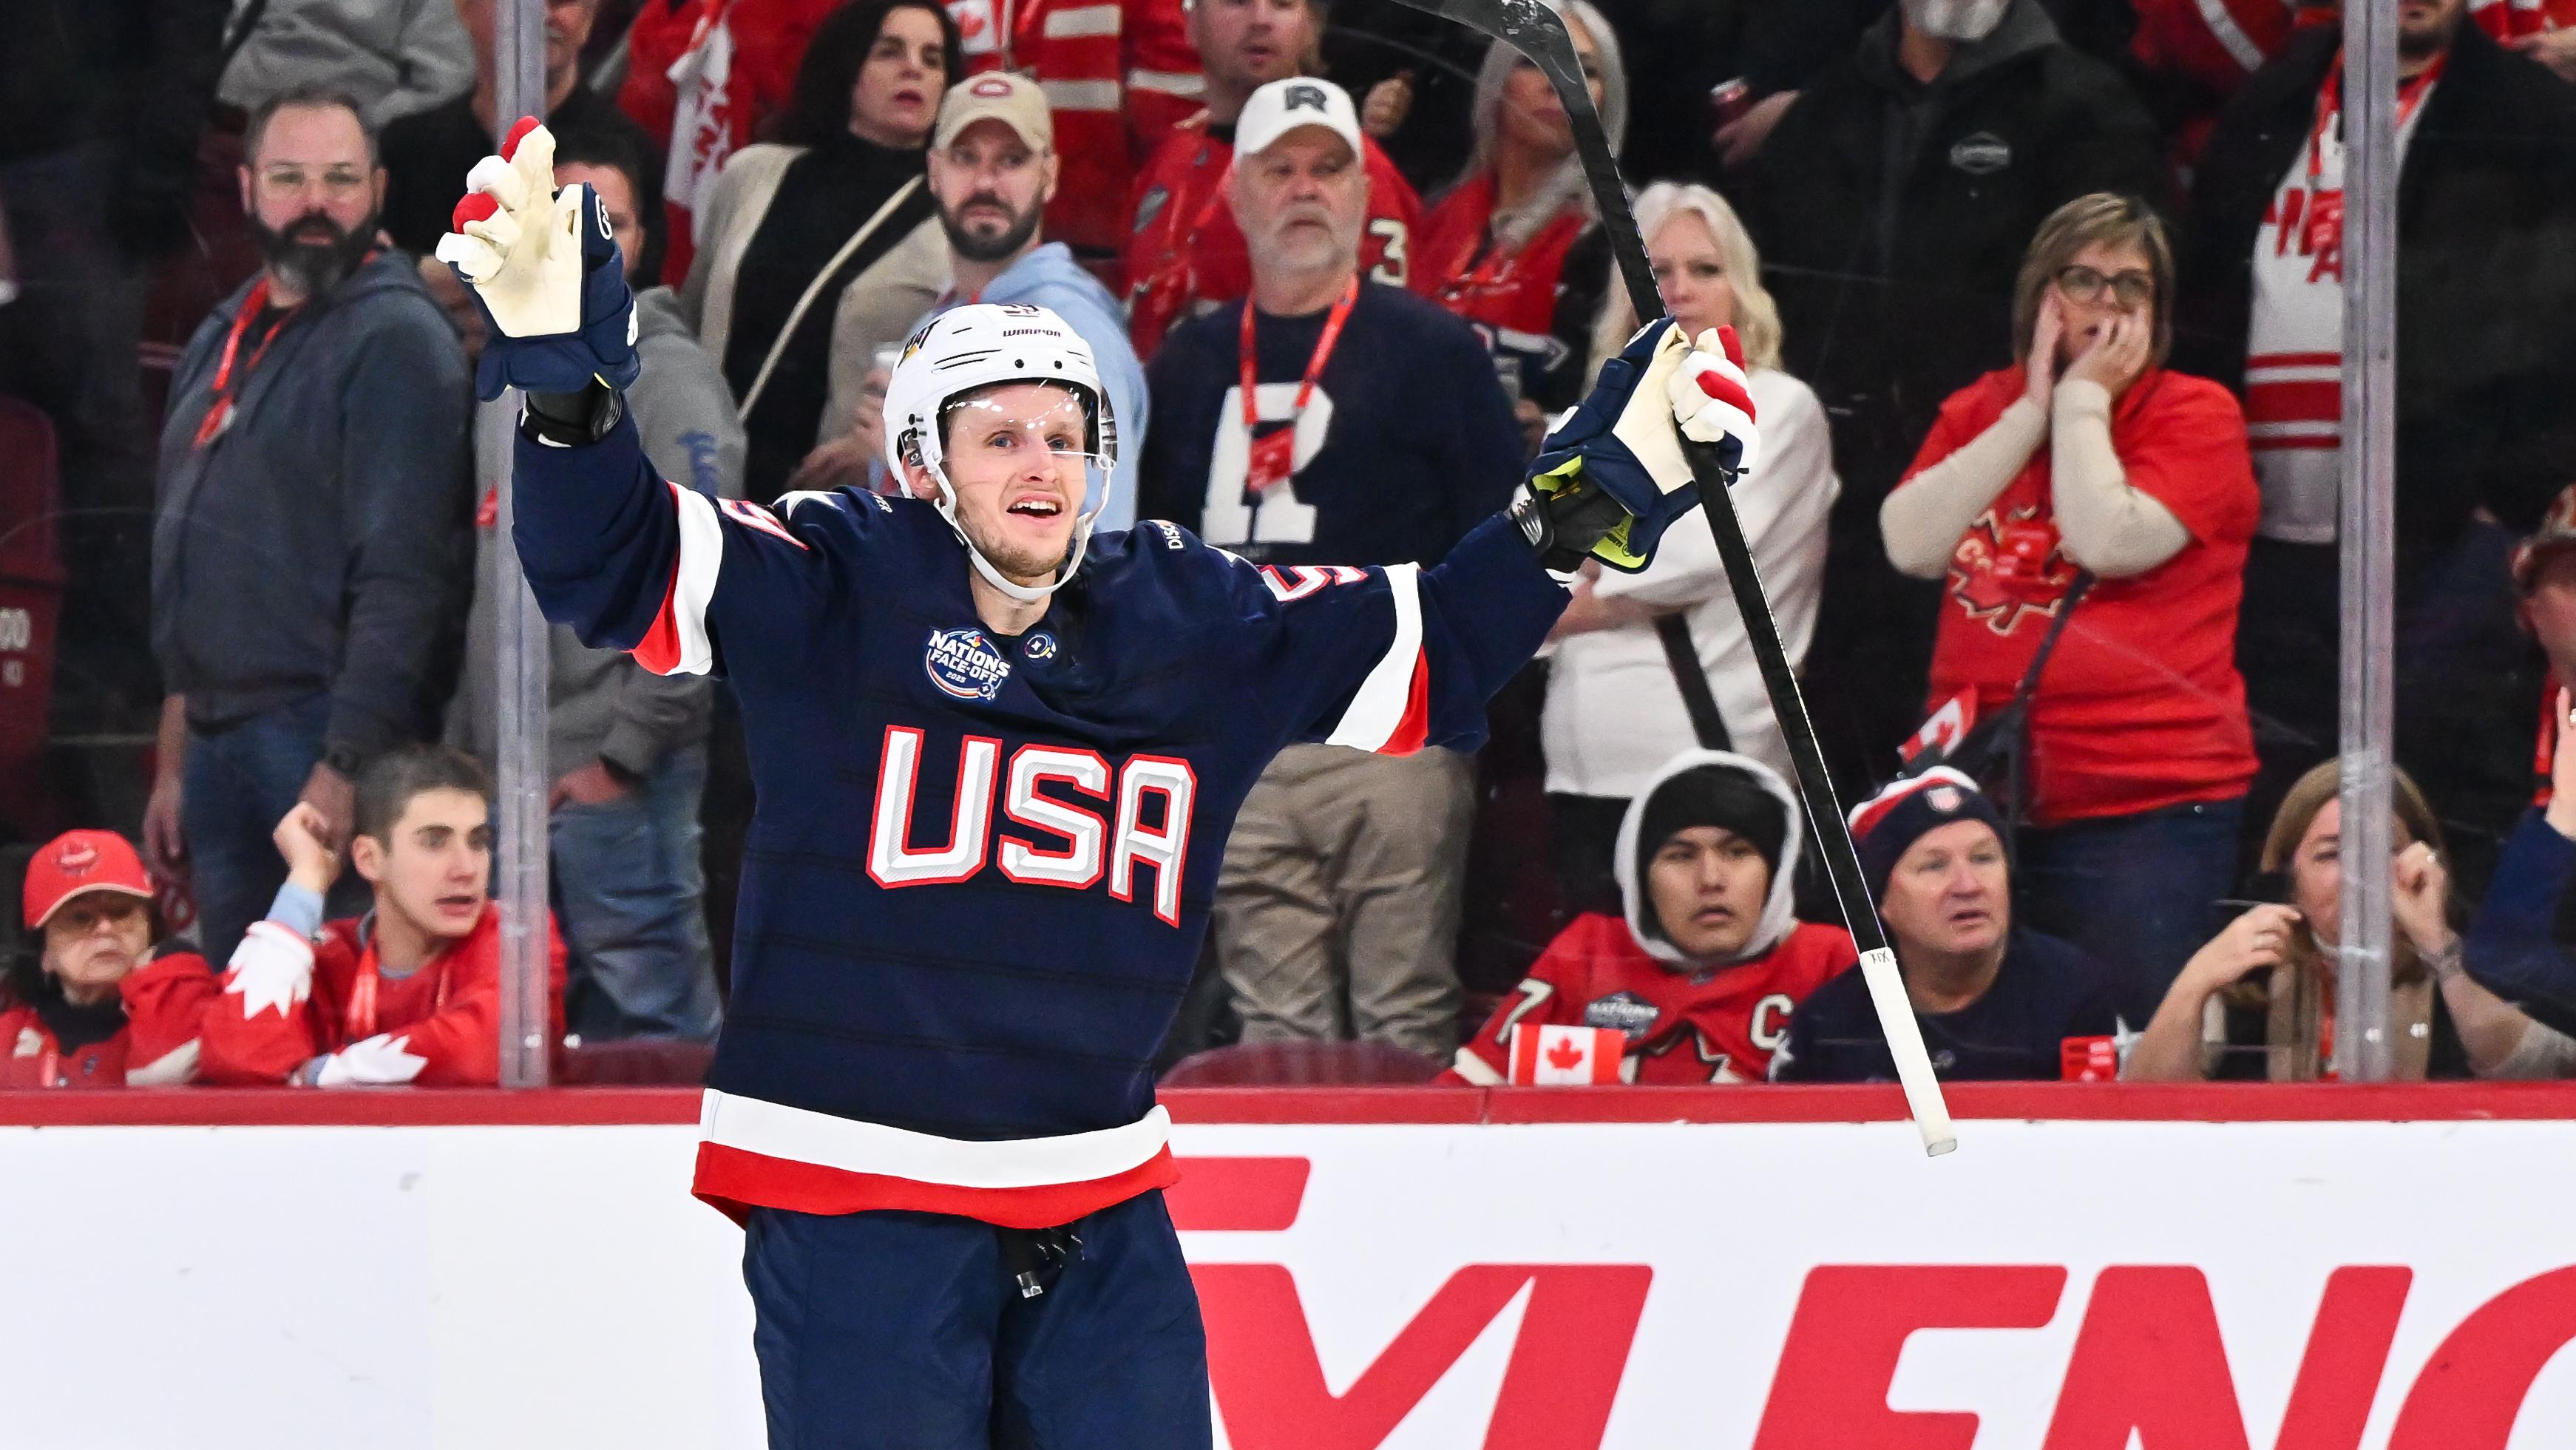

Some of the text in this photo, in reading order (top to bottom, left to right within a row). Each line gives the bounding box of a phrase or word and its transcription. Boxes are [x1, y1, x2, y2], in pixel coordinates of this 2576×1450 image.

[1369, 218, 1407, 288] 3
[1200, 382, 1334, 546] R
[928, 629, 1011, 678] NATIONS
[929, 648, 999, 684] FACE-OFF
[866, 724, 1198, 929] USA
[1750, 994, 1794, 1051] C
